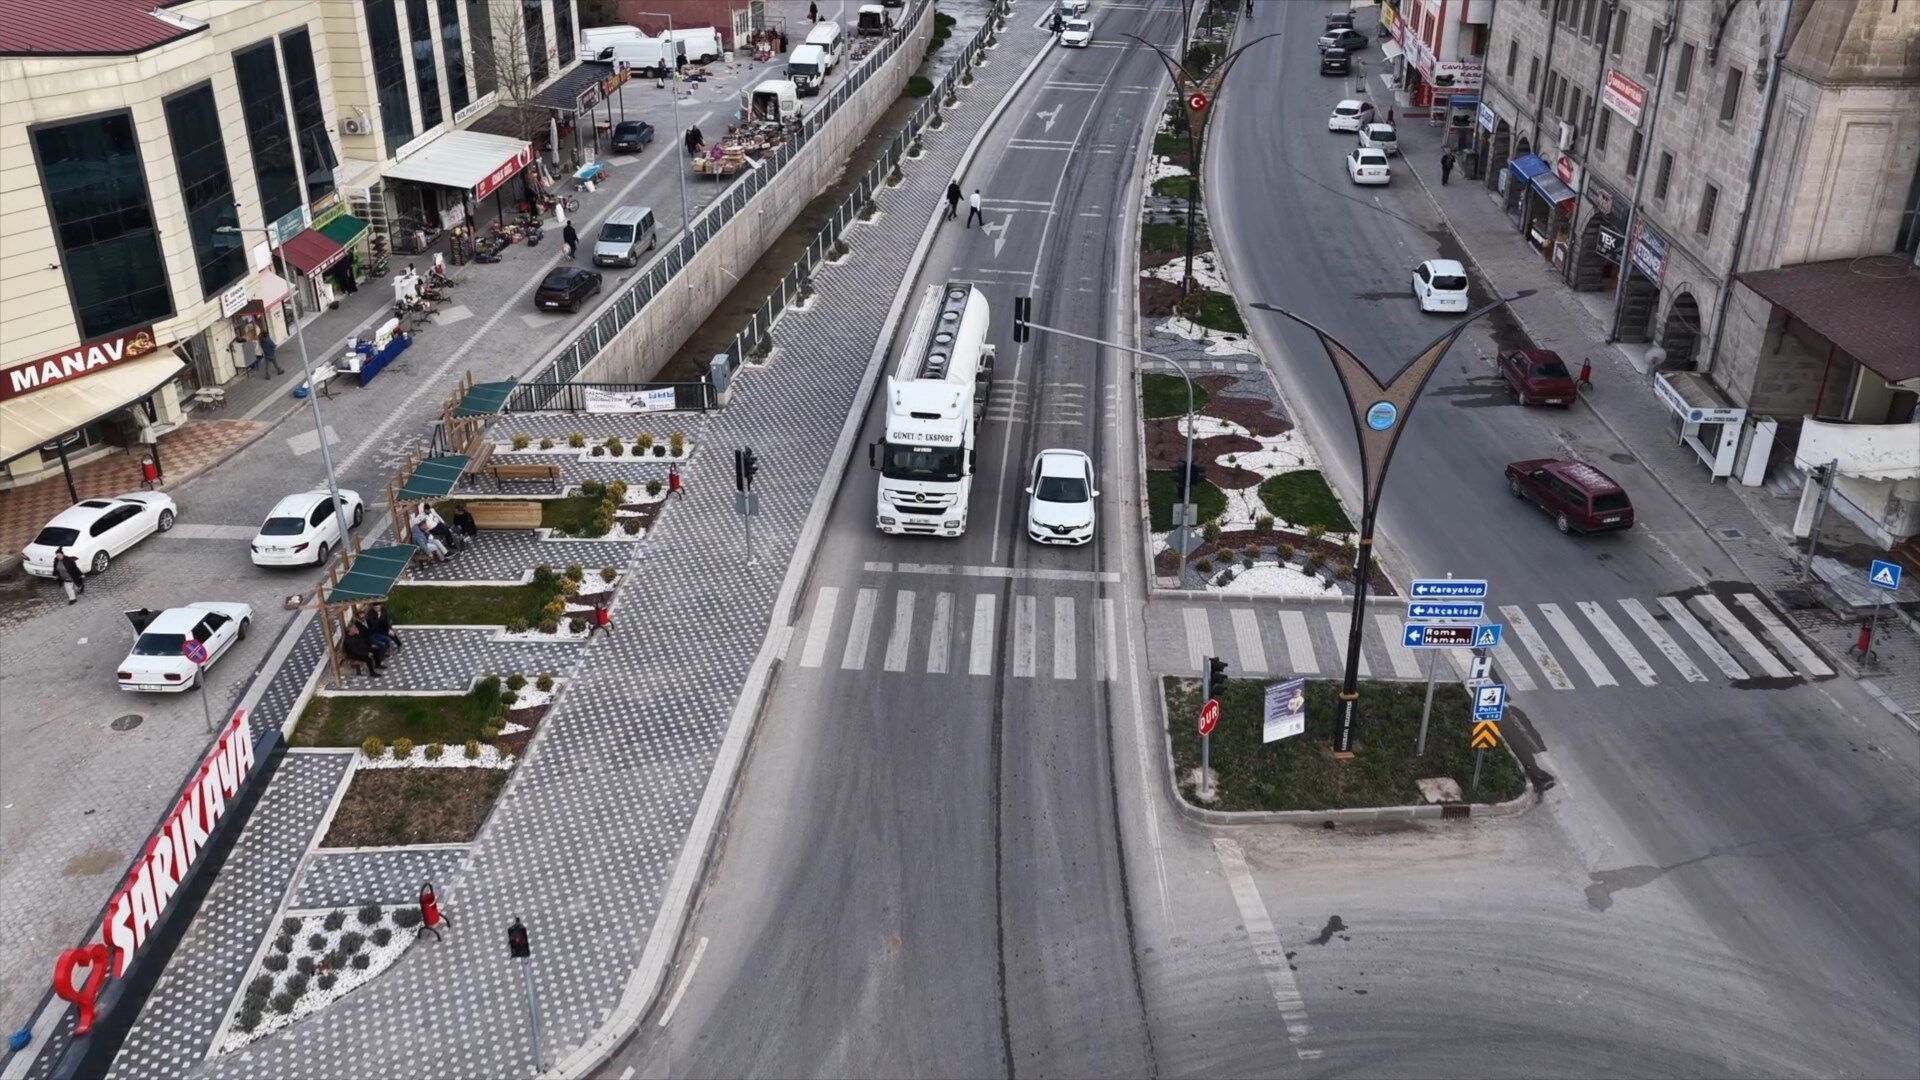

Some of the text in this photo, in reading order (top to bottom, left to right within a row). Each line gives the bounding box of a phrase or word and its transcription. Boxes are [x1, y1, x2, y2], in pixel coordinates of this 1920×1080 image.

[1600, 231, 1617, 249] TEK
[9, 338, 125, 393] MANAV
[925, 433, 954, 443] EKSPORT
[1429, 585, 1483, 595] Karayakup
[1426, 606, 1479, 616] Akçakışla
[1426, 628, 1457, 636] Roma
[1424, 636, 1470, 644] Hamamı
[1200, 705, 1217, 730] DUR
[108, 709, 255, 979] SARIKAYA
